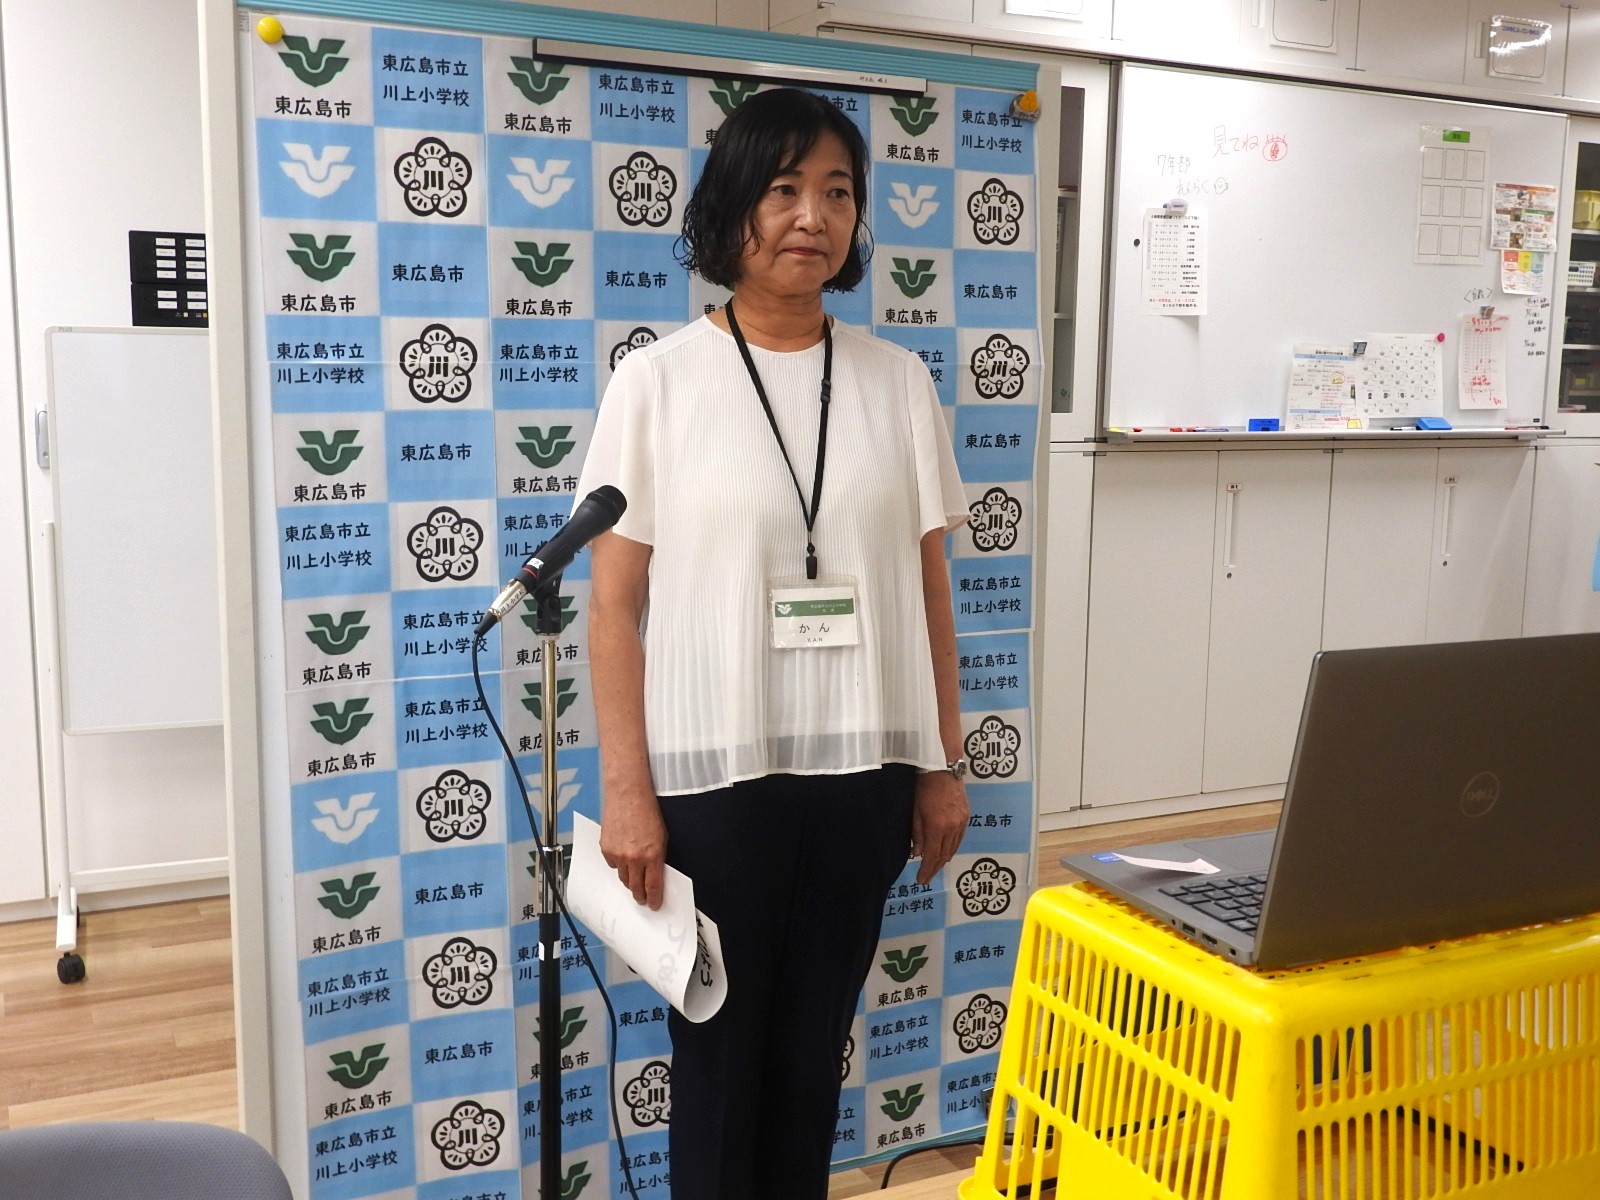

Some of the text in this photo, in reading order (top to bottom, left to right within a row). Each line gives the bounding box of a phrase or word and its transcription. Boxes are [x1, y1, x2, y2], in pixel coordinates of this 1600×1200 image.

[382, 55, 469, 76] 東広島市立
[598, 74, 675, 95] 東広島市立
[383, 86, 470, 107] 川上小学校
[275, 96, 352, 118] 東広島市
[599, 103, 675, 123] 川上小学校
[504, 113, 572, 134] 東広島市
[961, 135, 1023, 154] 川上小学校
[1213, 125, 1259, 158] 見てね
[886, 144, 940, 162] 東広島市
[392, 264, 464, 282] 東広島市
[605, 270, 668, 288] 東広島市
[963, 284, 1018, 300] 東広島市
[281, 294, 356, 313] 東広島市
[505, 298, 573, 316] 東広島市
[884, 308, 938, 325] 東広島市
[277, 342, 365, 359] 東広島市立
[500, 343, 579, 360] 東広島市立
[277, 367, 365, 384] 川上小学校
[500, 366, 579, 383] 川上小学校
[965, 434, 1022, 449] 東広島市
[400, 443, 472, 461] 東広島市
[294, 483, 366, 502] 東広島市
[512, 475, 578, 493] 東広島市
[504, 512, 570, 531] 東広島市
[285, 522, 371, 542] 東広島市立
[286, 551, 372, 570] 川上小学校
[959, 576, 1021, 592] 東広島市立
[960, 598, 1021, 614] 川上小学校
[403, 610, 486, 629] 東広島市立
[404, 637, 488, 656] 川上小学校
[958, 653, 1018, 669] 東広島市立
[302, 662, 372, 685] 東広島市
[958, 675, 1019, 691] 川上小学校
[405, 698, 485, 717] 東広島市立
[405, 723, 488, 743] 川上小学校
[307, 752, 376, 777] 東広島市
[968, 814, 1013, 828] 広島市
[414, 882, 484, 905] 東広島市
[887, 883, 933, 899] 広島市立
[885, 897, 934, 916] 上小学校
[312, 926, 382, 953] 東広島市
[517, 933, 588, 962] 東広市立
[953, 945, 1006, 963] 東広島市
[519, 953, 593, 981] 川学校
[307, 967, 389, 997] 東広島市立
[309, 987, 391, 1017] 川上小学校
[878, 985, 928, 1007] 東広島市
[619, 1006, 671, 1027] 東広島
[870, 1015, 929, 1039] 東広島市立
[424, 1041, 493, 1064] 東広島市
[869, 1035, 929, 1060] 川上小学校
[530, 1051, 590, 1079] 東島市
[324, 1090, 393, 1119] 東広島市
[523, 1084, 592, 1116] 東市立
[947, 1095, 981, 1114] 川上小
[524, 1107, 594, 1140] 川学校
[316, 1125, 397, 1156] 東広島市立
[877, 1123, 926, 1148] 東広島市
[316, 1150, 398, 1181] 川上小学校
[619, 1151, 670, 1171] 東広島
[619, 1173, 671, 1194] 川上小
